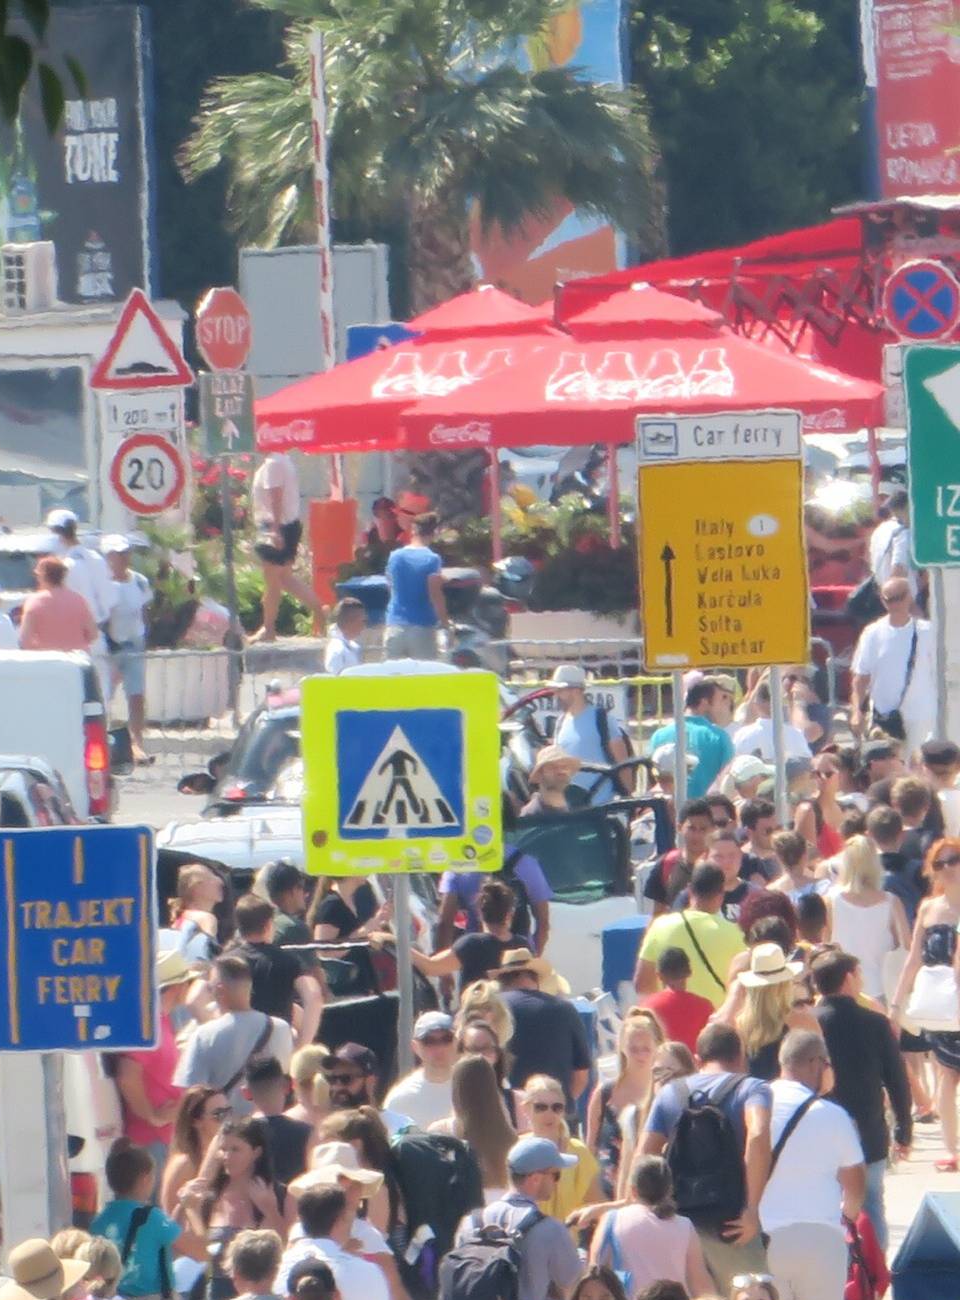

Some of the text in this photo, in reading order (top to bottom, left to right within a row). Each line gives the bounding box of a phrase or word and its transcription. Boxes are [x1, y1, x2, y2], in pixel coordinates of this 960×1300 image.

[202, 316, 247, 345] STOP
[693, 423, 782, 447] Car ferry
[127, 457, 165, 490] 20
[695, 518, 734, 537] Italy
[741, 564, 780, 581] Luka
[700, 636, 765, 657] Supetar
[20, 897, 135, 930] TRAJEKT
[51, 937, 106, 967] CAR
[36, 974, 121, 1005] FERRY
